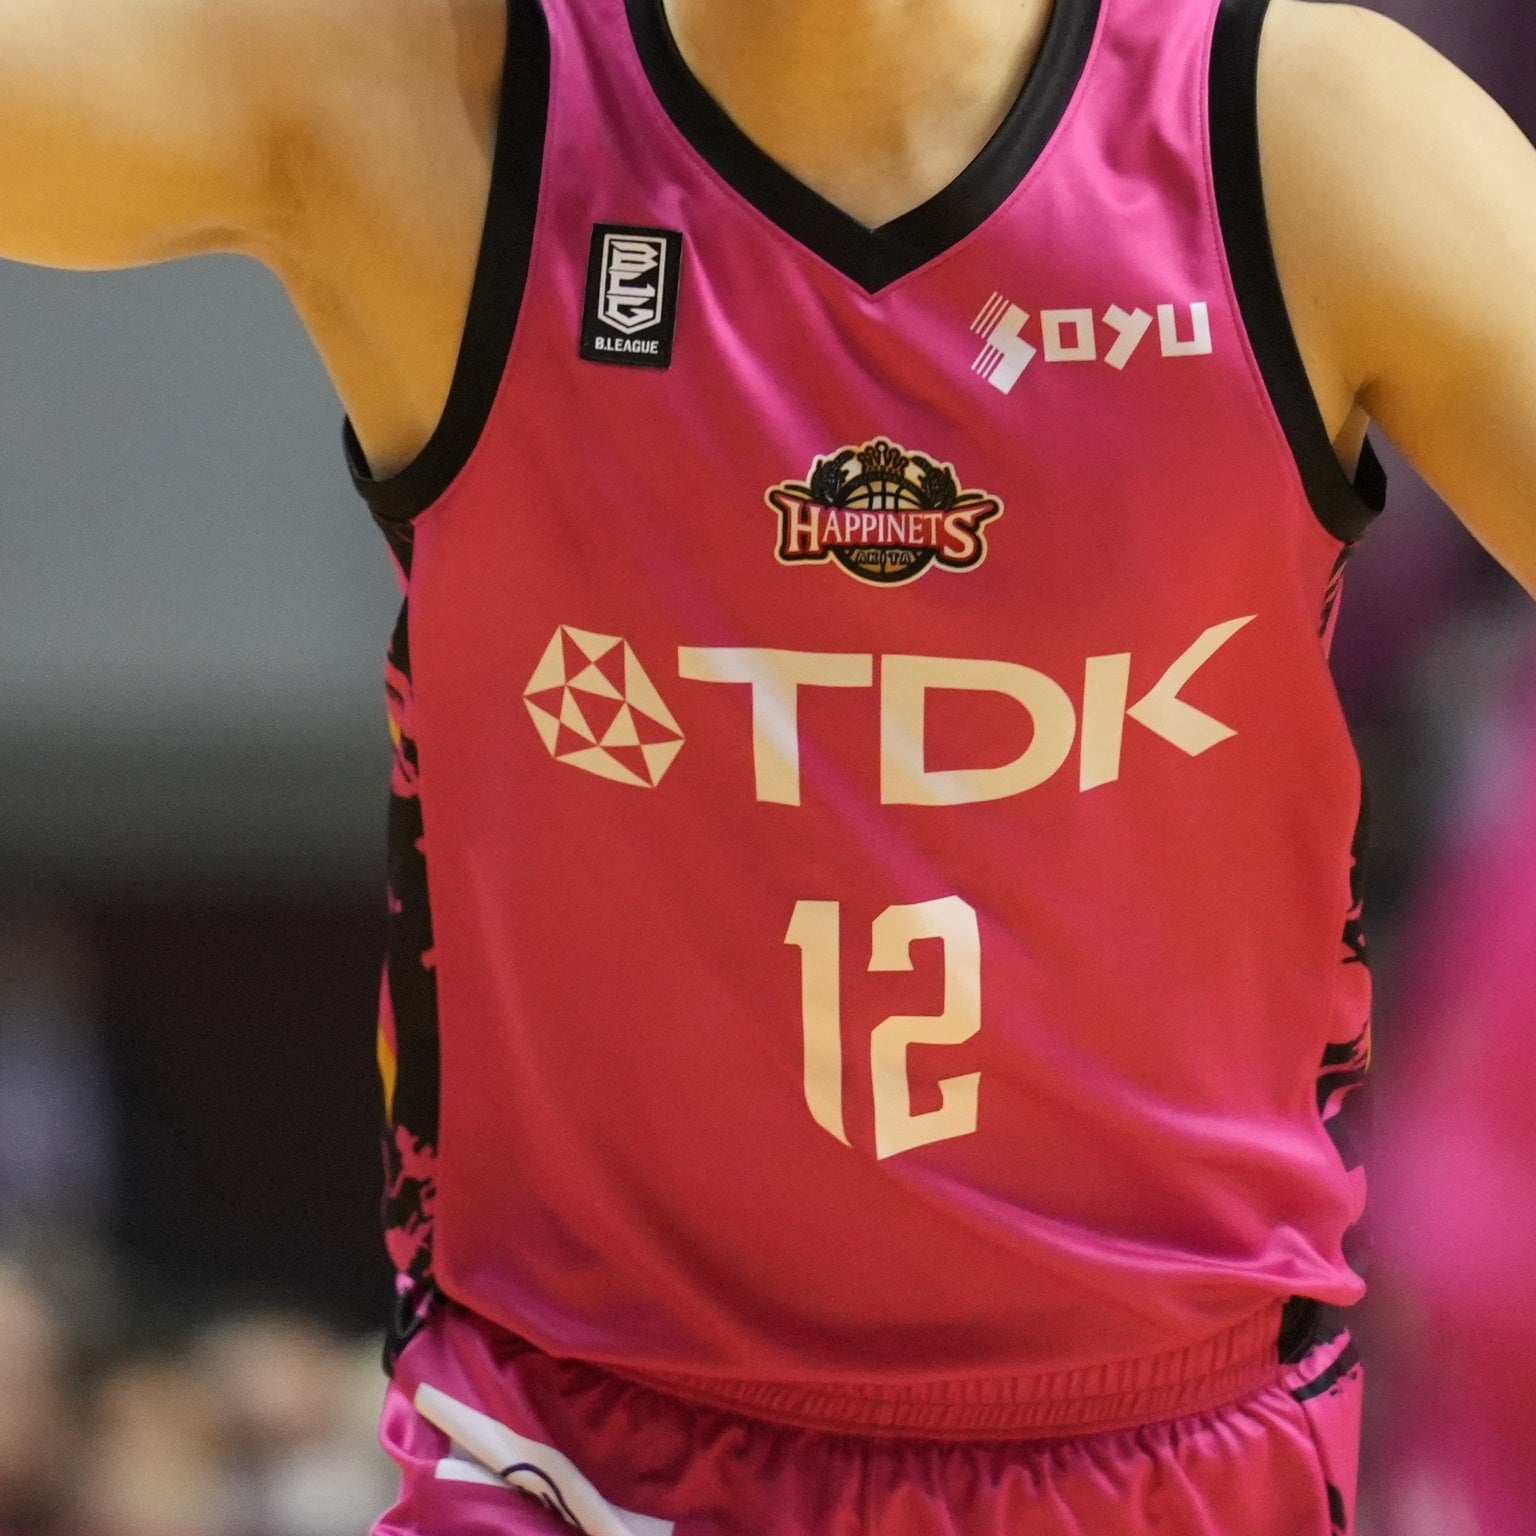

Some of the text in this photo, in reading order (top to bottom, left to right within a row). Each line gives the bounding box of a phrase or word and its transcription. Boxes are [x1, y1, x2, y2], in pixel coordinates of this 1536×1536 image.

[594, 336, 659, 355] B.LEAGUE
[775, 497, 995, 558] HAPPINETS
[855, 550, 912, 564] AKITA
[678, 614, 1258, 806] TDK
[784, 894, 982, 1161] 12
